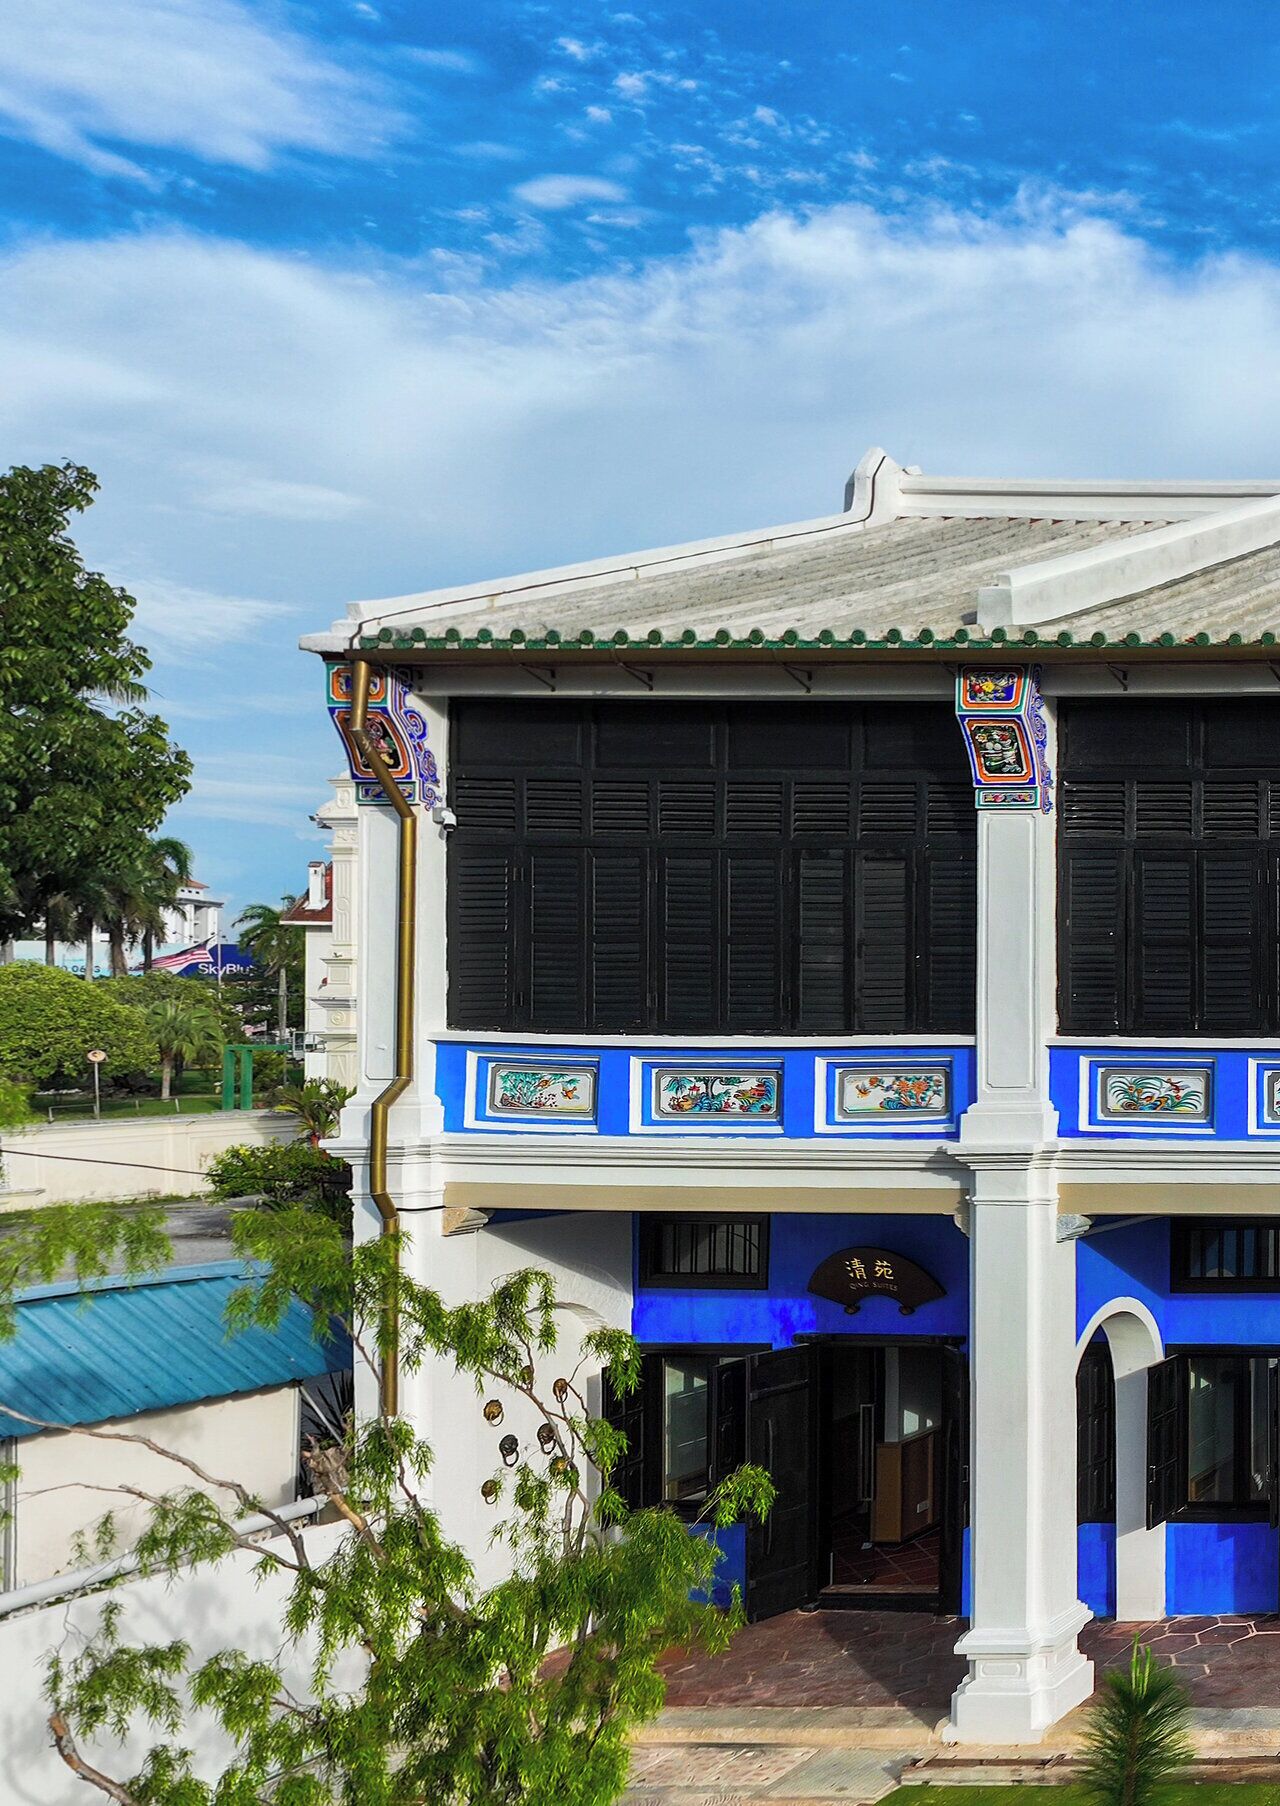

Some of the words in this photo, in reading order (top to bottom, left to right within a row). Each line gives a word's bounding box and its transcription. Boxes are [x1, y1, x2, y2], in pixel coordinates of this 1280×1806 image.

[844, 1257, 895, 1280] 清苑
[849, 1282, 870, 1290] QING
[872, 1282, 898, 1292] SUITES
